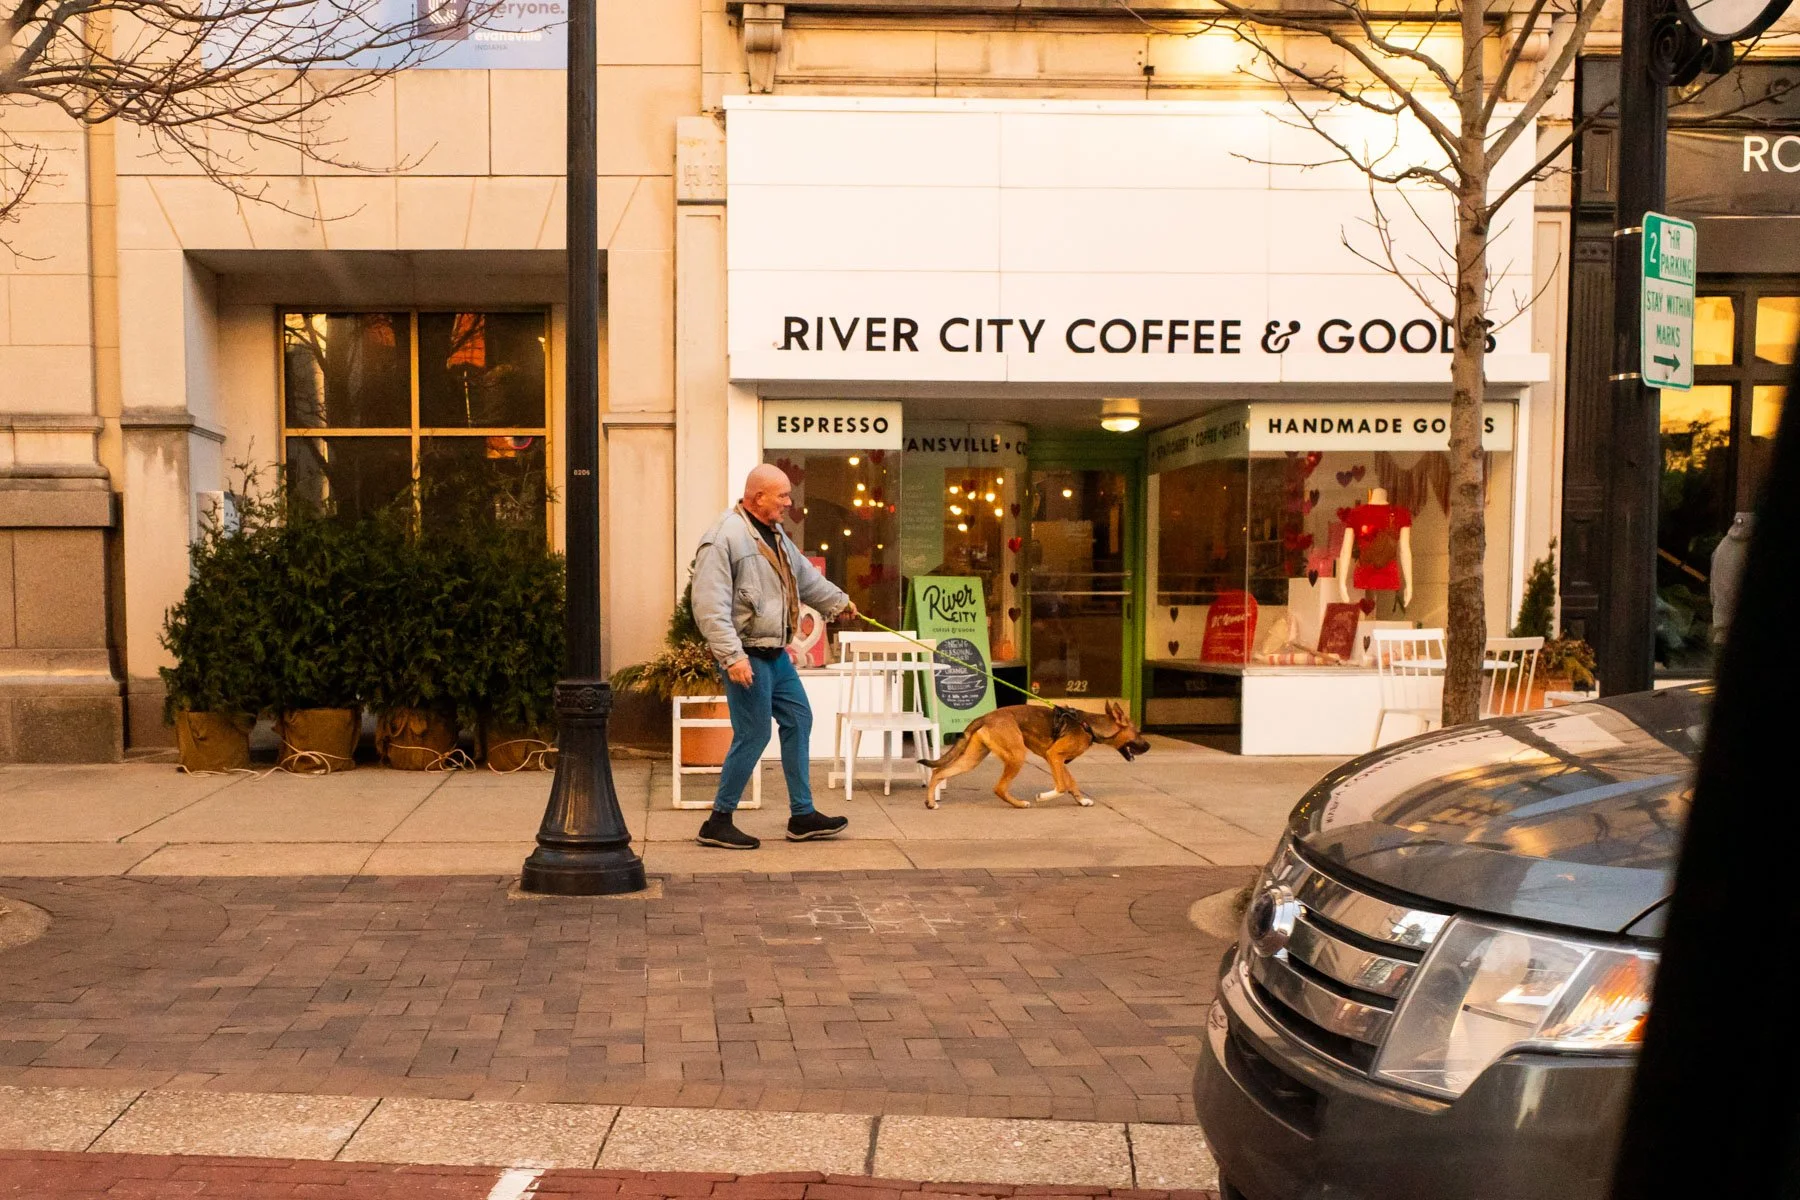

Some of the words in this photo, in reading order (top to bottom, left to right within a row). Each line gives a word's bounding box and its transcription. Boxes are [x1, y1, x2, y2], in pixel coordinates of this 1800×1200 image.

[475, 2, 565, 18] eeryone.
[474, 30, 542, 42] evansville
[1649, 232, 1658, 264] 2
[1669, 230, 1681, 251] HR
[1661, 253, 1692, 280] PARKING
[1646, 290, 1663, 313] STAY
[1667, 294, 1692, 318] WITHIN
[783, 316, 919, 352] RIVER
[939, 318, 1045, 354] CITY
[1065, 318, 1241, 354] COFFEE
[1261, 319, 1301, 354] &
[1656, 323, 1681, 348] MARKS
[777, 416, 889, 434] ESPRESSO
[1268, 417, 1402, 434] HANDMADE
[1413, 417, 1495, 434] GOS
[923, 585, 976, 621] River
[952, 611, 977, 623] CITY
[1066, 680, 1088, 692] 223
